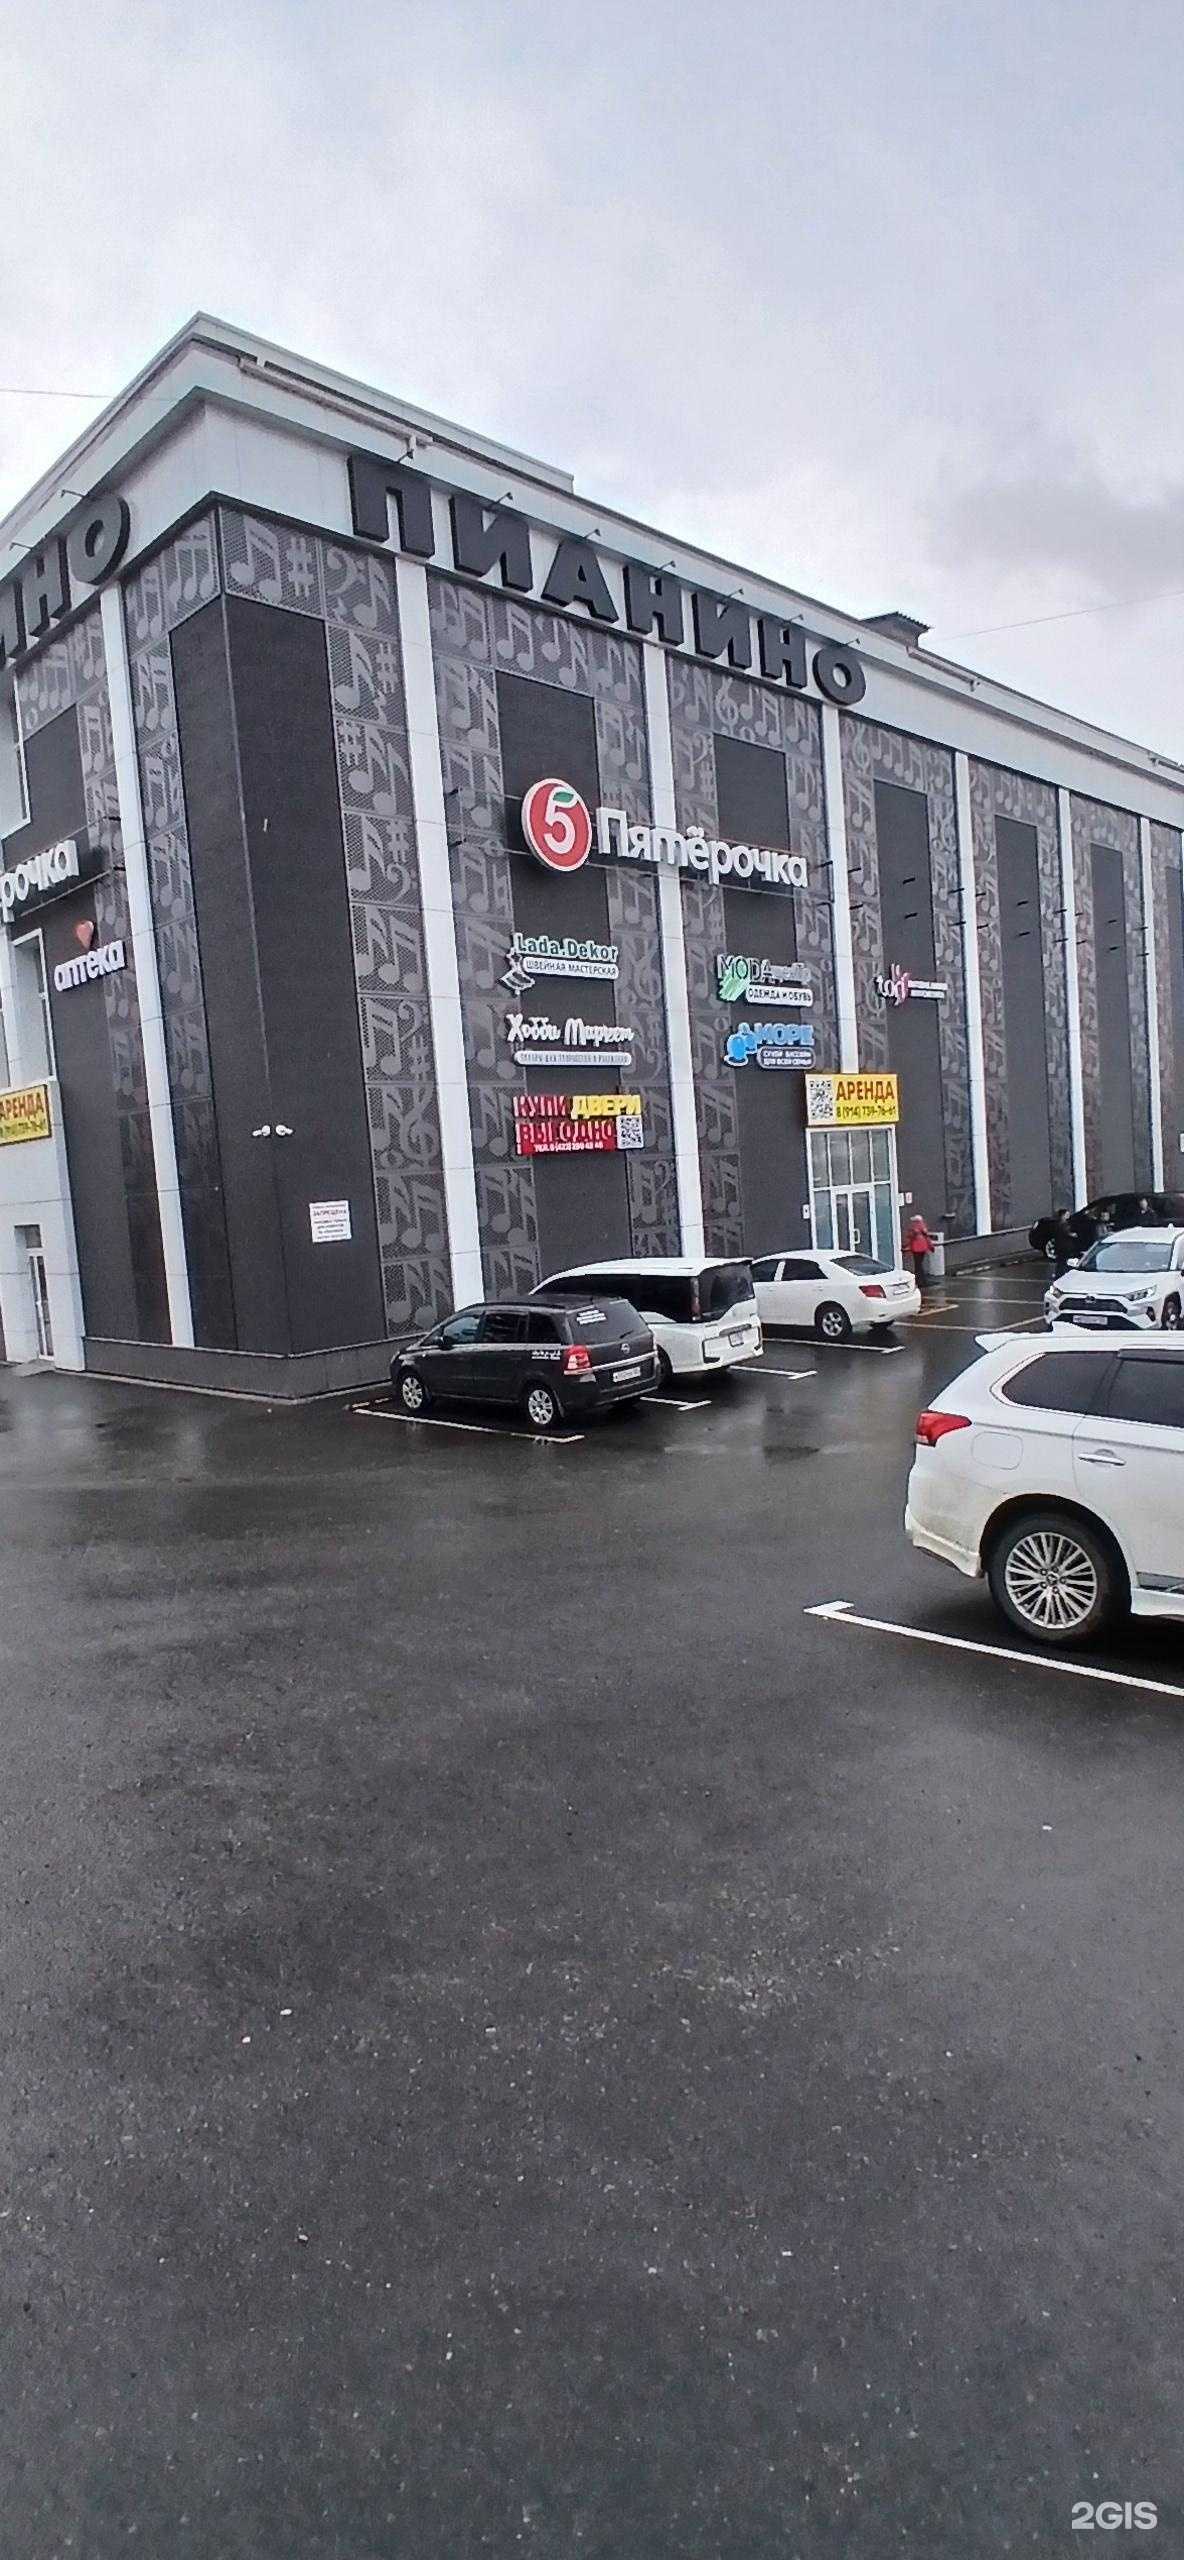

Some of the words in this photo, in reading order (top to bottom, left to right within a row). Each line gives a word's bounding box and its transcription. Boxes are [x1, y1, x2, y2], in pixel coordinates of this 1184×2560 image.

[347, 454, 867, 707] ПИАНИНО
[596, 806, 809, 889] Пятёрочка
[54, 940, 127, 991] аптека
[754, 1022, 815, 1046] МОРЕ
[836, 1080, 895, 1104] АРЕНДА
[513, 1095, 567, 1118] КУПИ
[570, 1094, 642, 1120] ДВЕРИ
[515, 1119, 614, 1144] ВЫГОДНО
